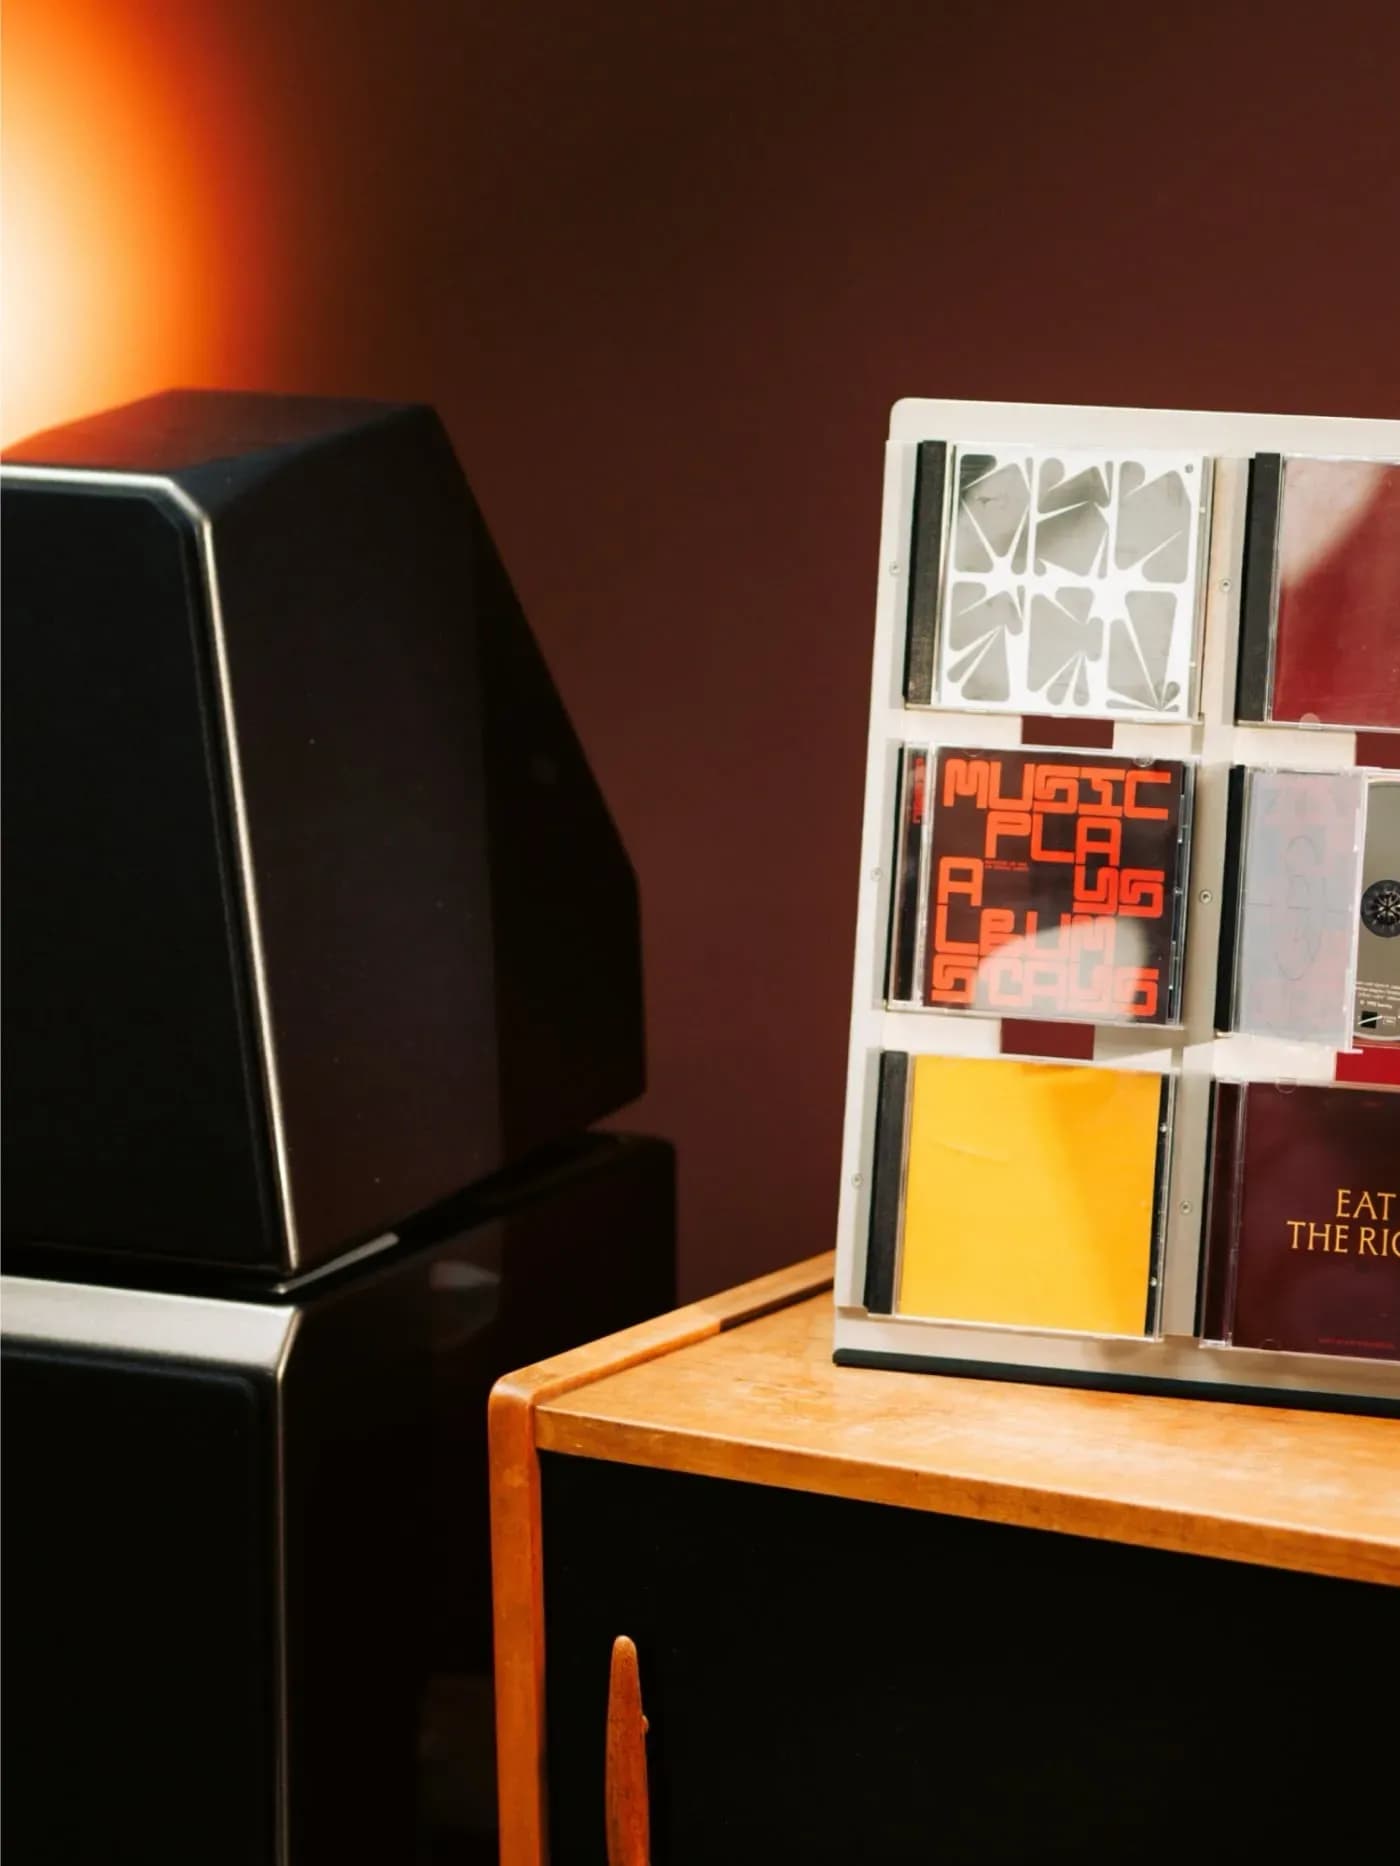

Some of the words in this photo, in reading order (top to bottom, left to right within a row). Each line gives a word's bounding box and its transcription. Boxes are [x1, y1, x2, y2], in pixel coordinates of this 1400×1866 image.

[943, 758, 1172, 820] MUSIC
[1335, 1188, 1397, 1221] EAT
[1286, 1220, 1349, 1254] THE
